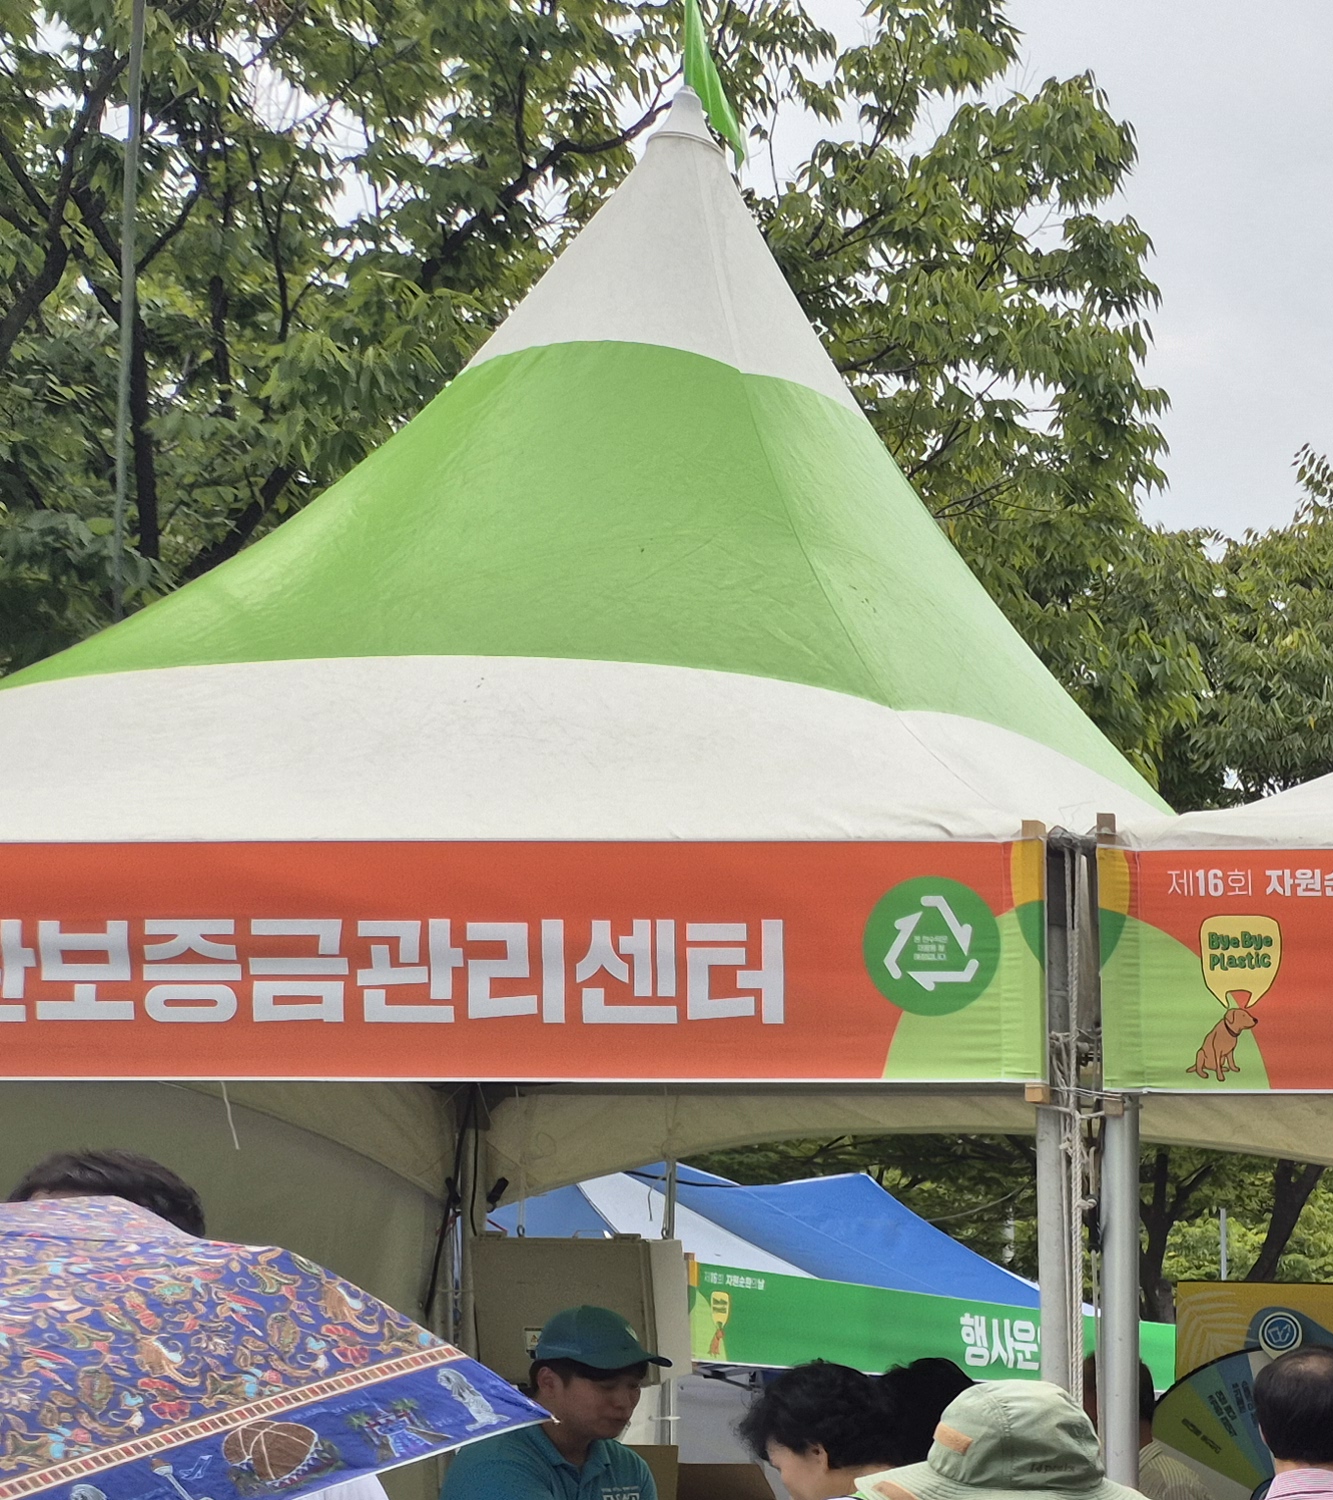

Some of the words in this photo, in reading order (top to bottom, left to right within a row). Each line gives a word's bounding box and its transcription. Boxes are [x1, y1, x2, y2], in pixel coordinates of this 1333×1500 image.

[1167, 868, 1252, 897] 제16회
[1208, 931, 1240, 951] Bye
[1241, 930, 1273, 951] Bye
[1209, 952, 1271, 971] Plastic
[959, 1311, 1041, 1371] 행사운
